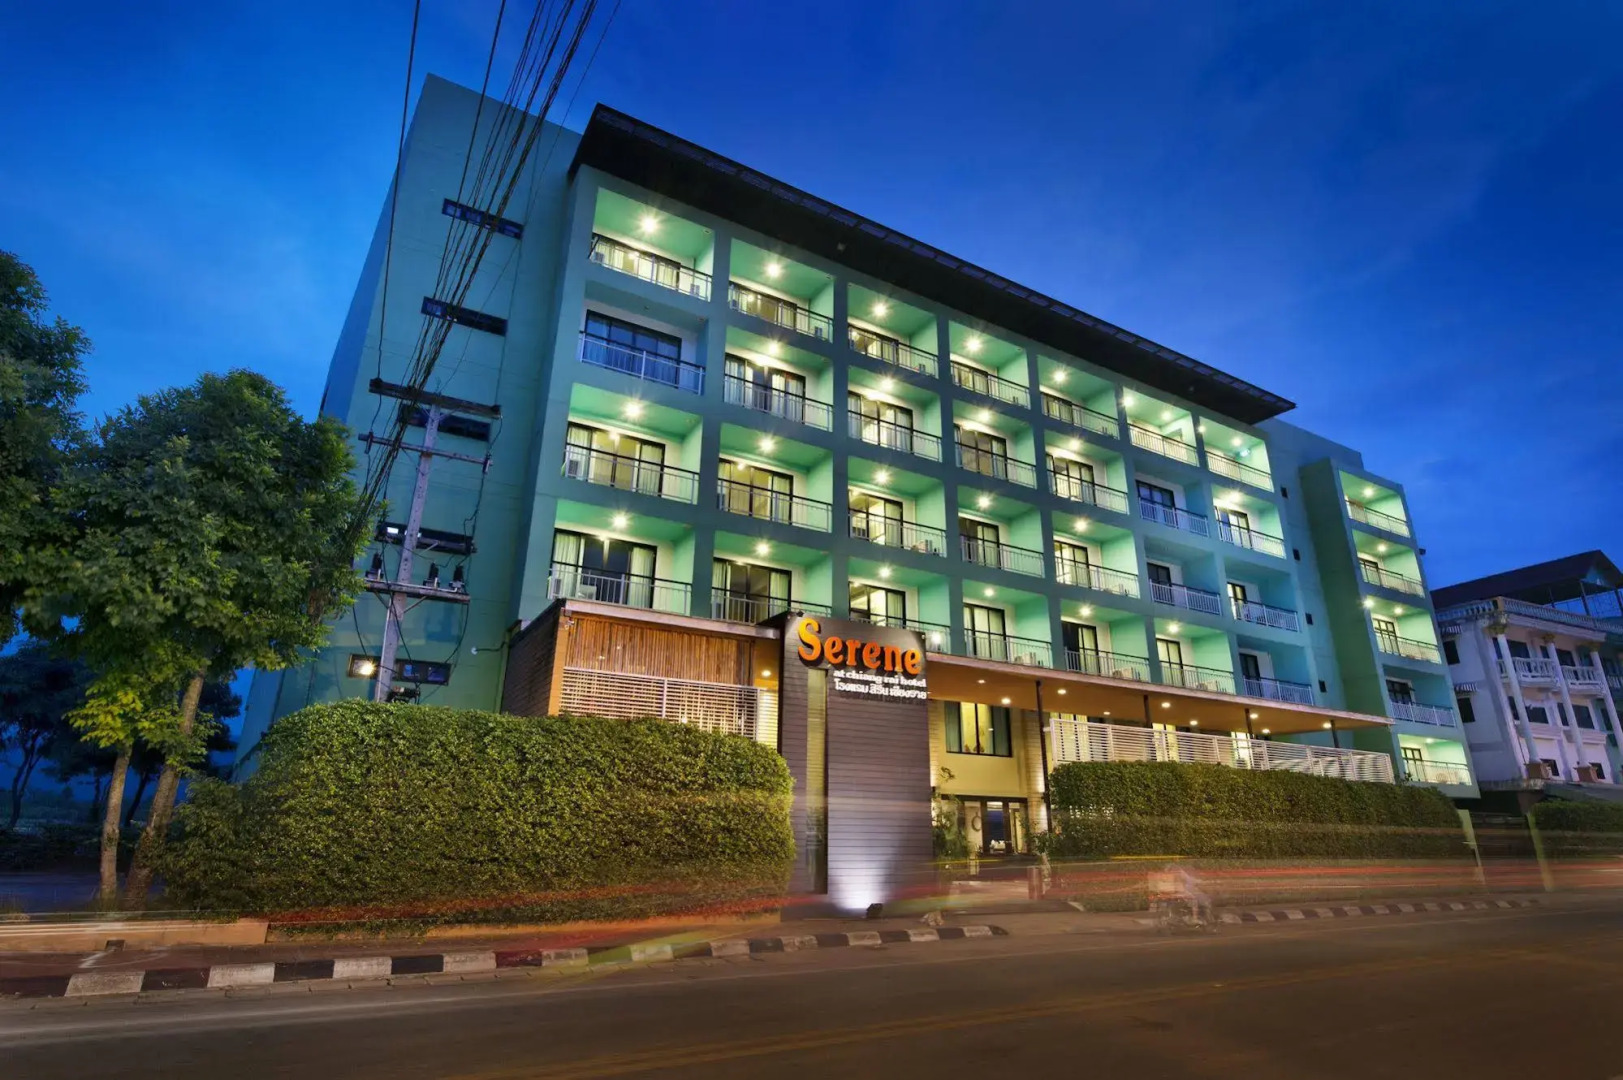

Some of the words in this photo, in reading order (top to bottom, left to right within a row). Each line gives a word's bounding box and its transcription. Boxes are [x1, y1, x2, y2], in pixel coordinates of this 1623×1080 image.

[798, 618, 922, 675] Serene
[833, 670, 845, 678] at
[846, 671, 882, 684] chiang
[884, 675, 899, 684] rai
[900, 677, 927, 687] hotel
